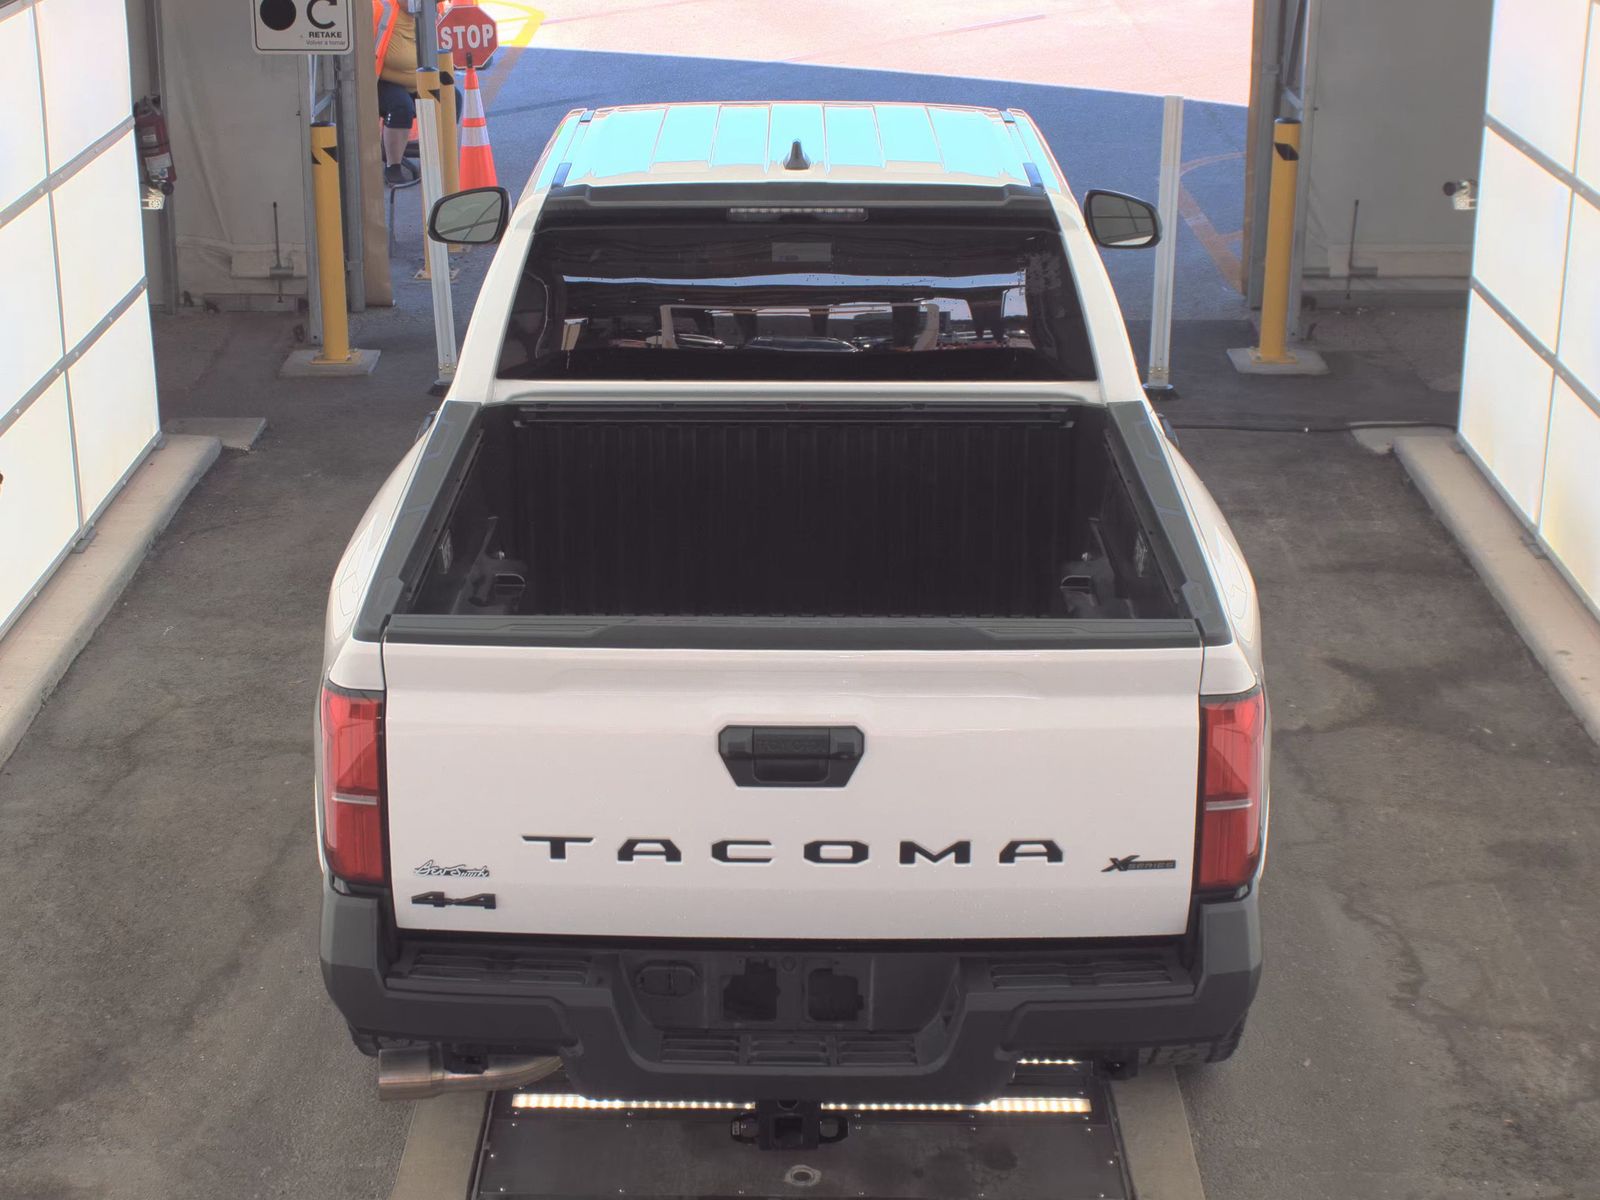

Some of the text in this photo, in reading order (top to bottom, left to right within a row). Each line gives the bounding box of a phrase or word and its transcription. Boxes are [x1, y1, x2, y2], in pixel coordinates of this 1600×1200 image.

[306, 0, 338, 29] C
[440, 24, 494, 50] STOP
[521, 835, 1064, 864] TACOMA
